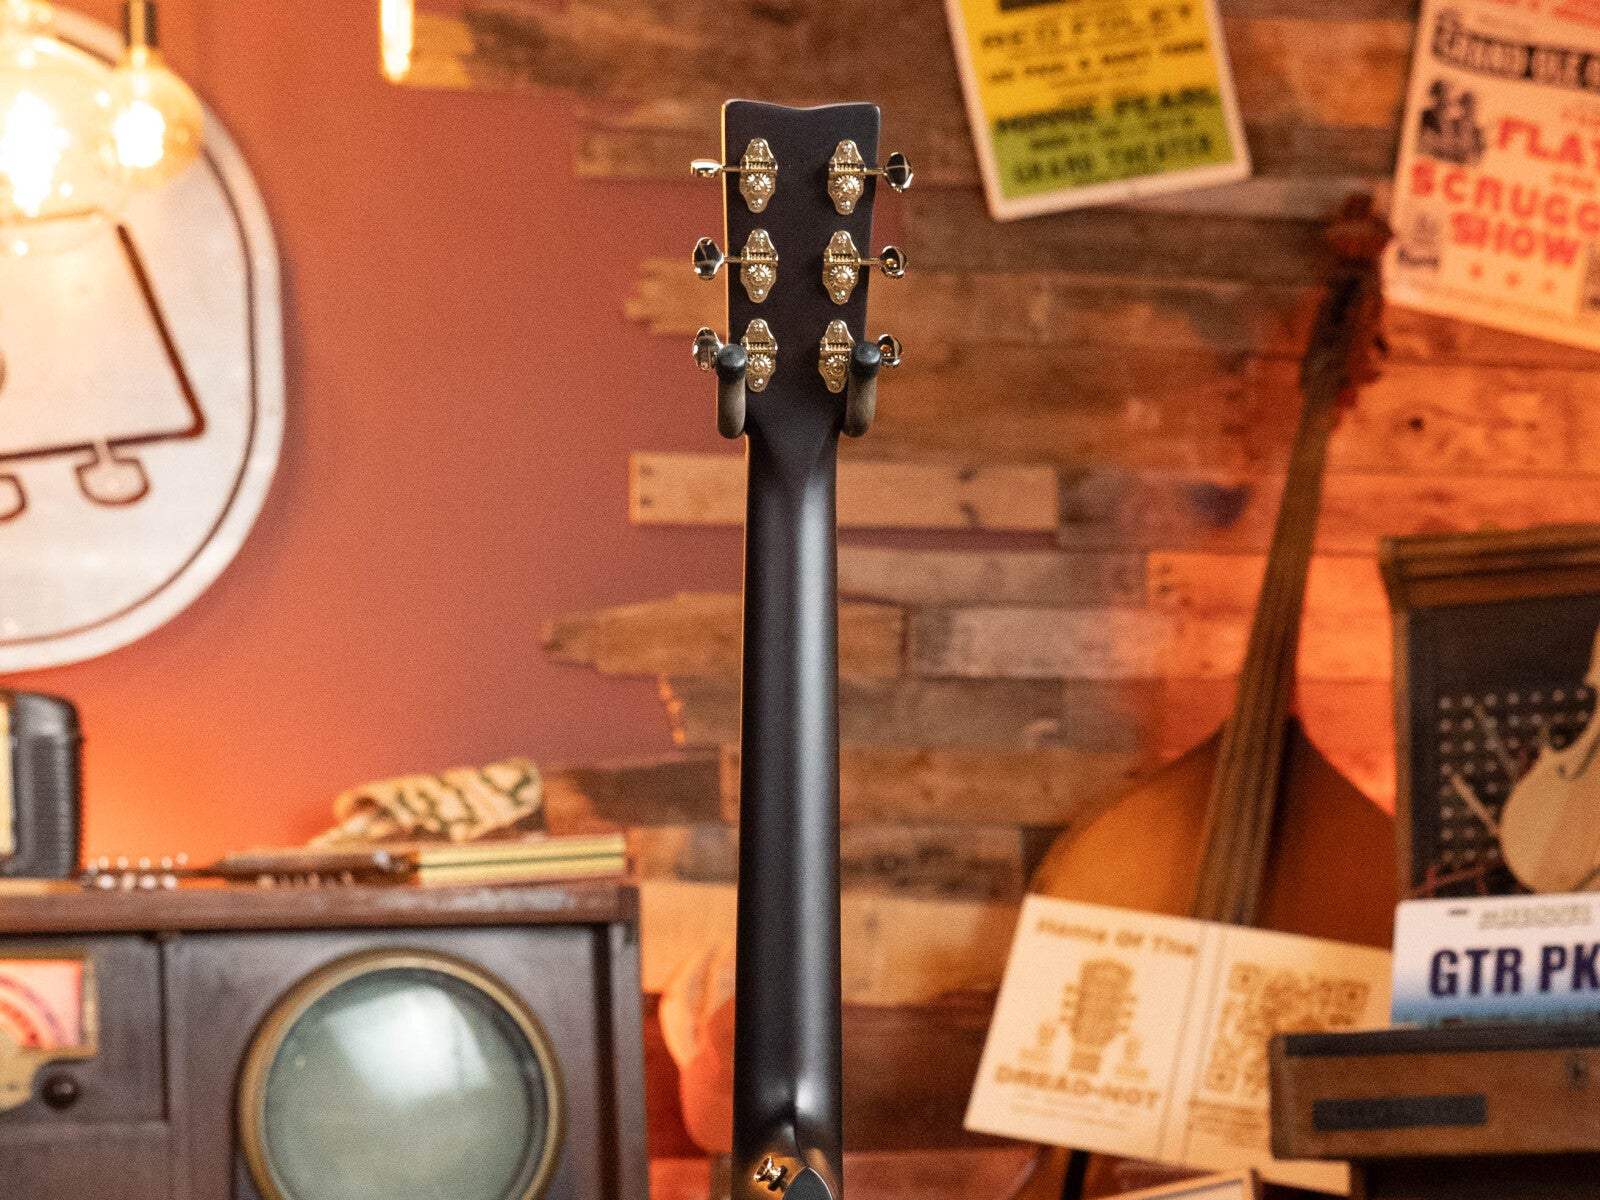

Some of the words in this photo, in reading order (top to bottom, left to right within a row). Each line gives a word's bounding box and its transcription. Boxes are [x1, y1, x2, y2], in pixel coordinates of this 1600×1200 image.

[1452, 211, 1580, 269] SHOW
[1036, 918, 1107, 943] Home
[1429, 945, 1523, 998] GTR
[1539, 941, 1600, 994] PK
[995, 1063, 1160, 1109] DREAD-NOT
